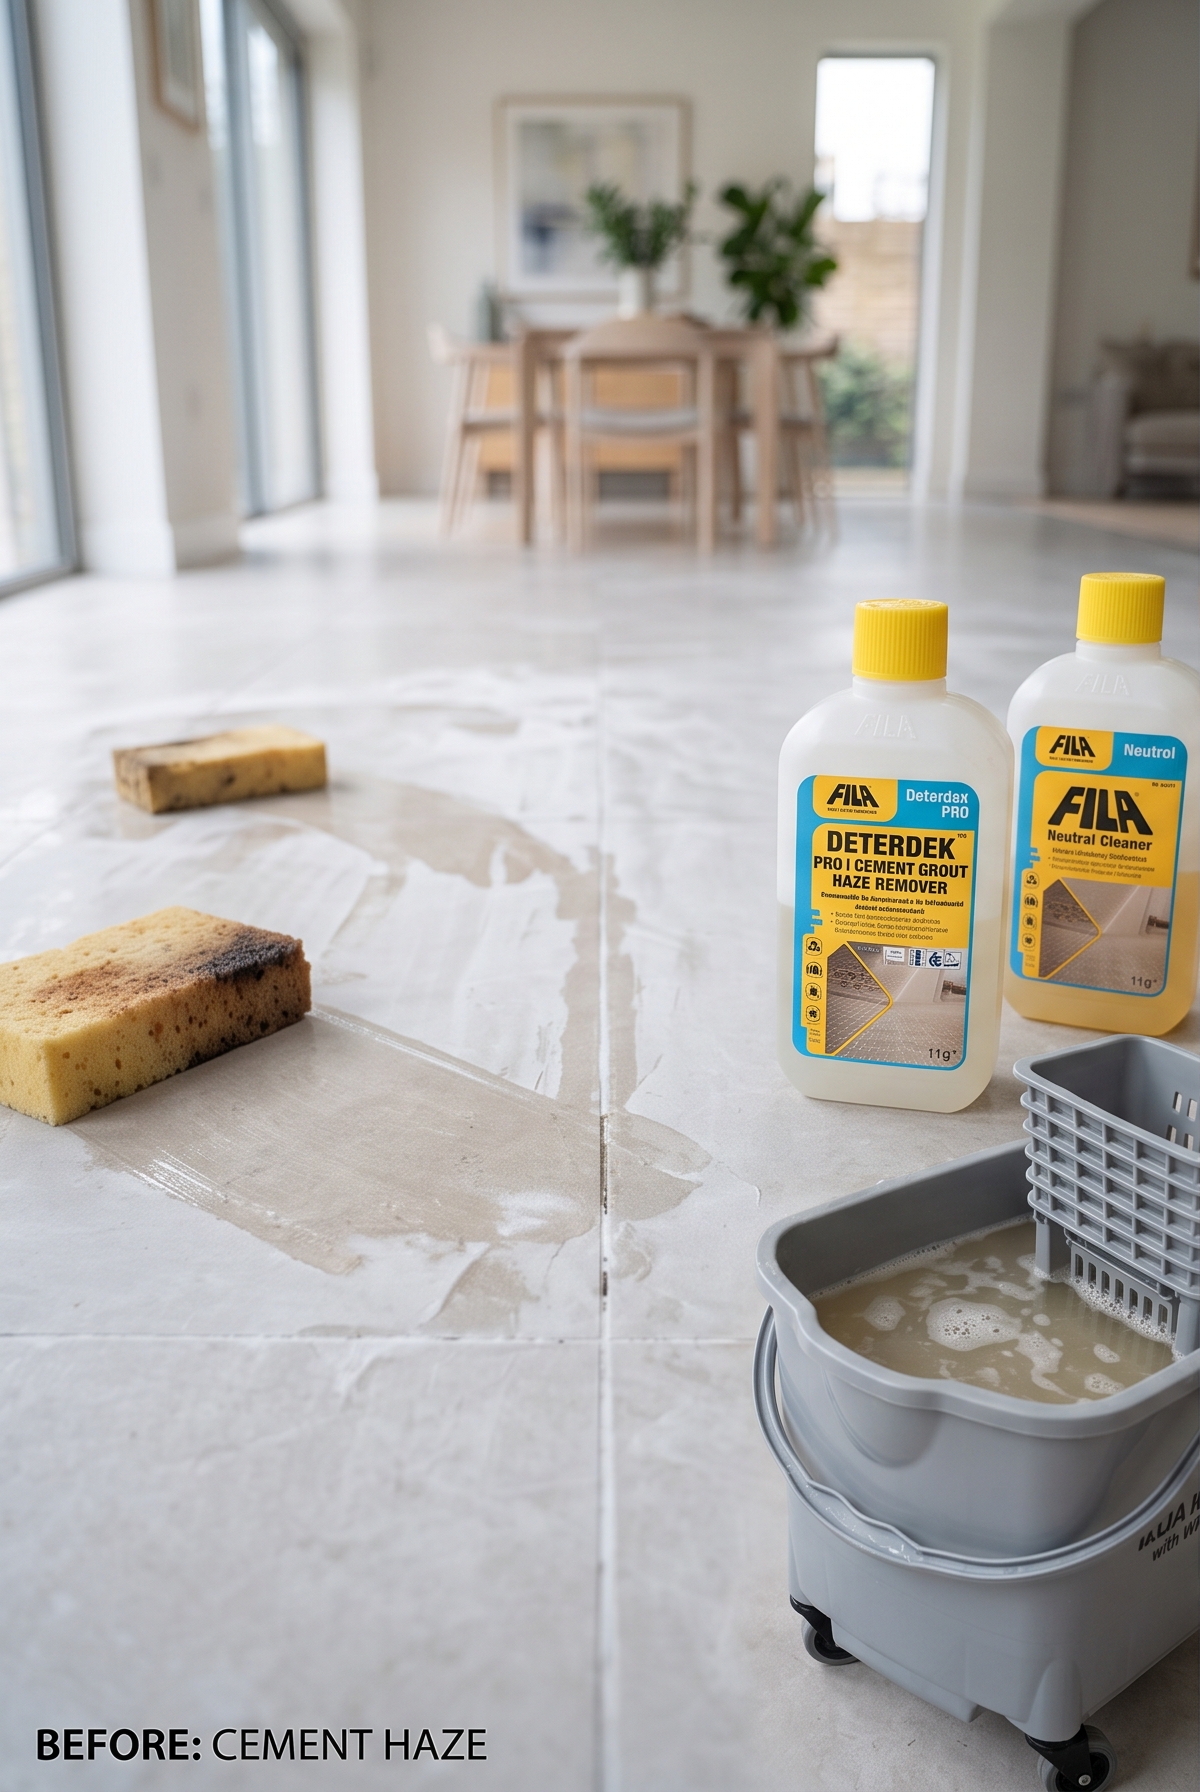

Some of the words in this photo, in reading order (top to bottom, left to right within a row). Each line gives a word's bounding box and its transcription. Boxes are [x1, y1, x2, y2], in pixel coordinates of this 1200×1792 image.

[1049, 735, 1097, 758] FILA
[826, 783, 880, 808] FILA
[941, 805, 969, 819] PRO
[1047, 786, 1154, 836] FILA
[827, 830, 956, 860] DETERDEK
[1047, 829, 1096, 847] Neutral
[1100, 835, 1153, 851] Cleaner
[813, 855, 843, 871] PRO
[854, 859, 915, 876] CEMENT
[918, 863, 968, 879] GROUT
[832, 874, 870, 890] HAZE
[875, 877, 948, 895] REMOVER
[1152, 1533, 1179, 1562] with
